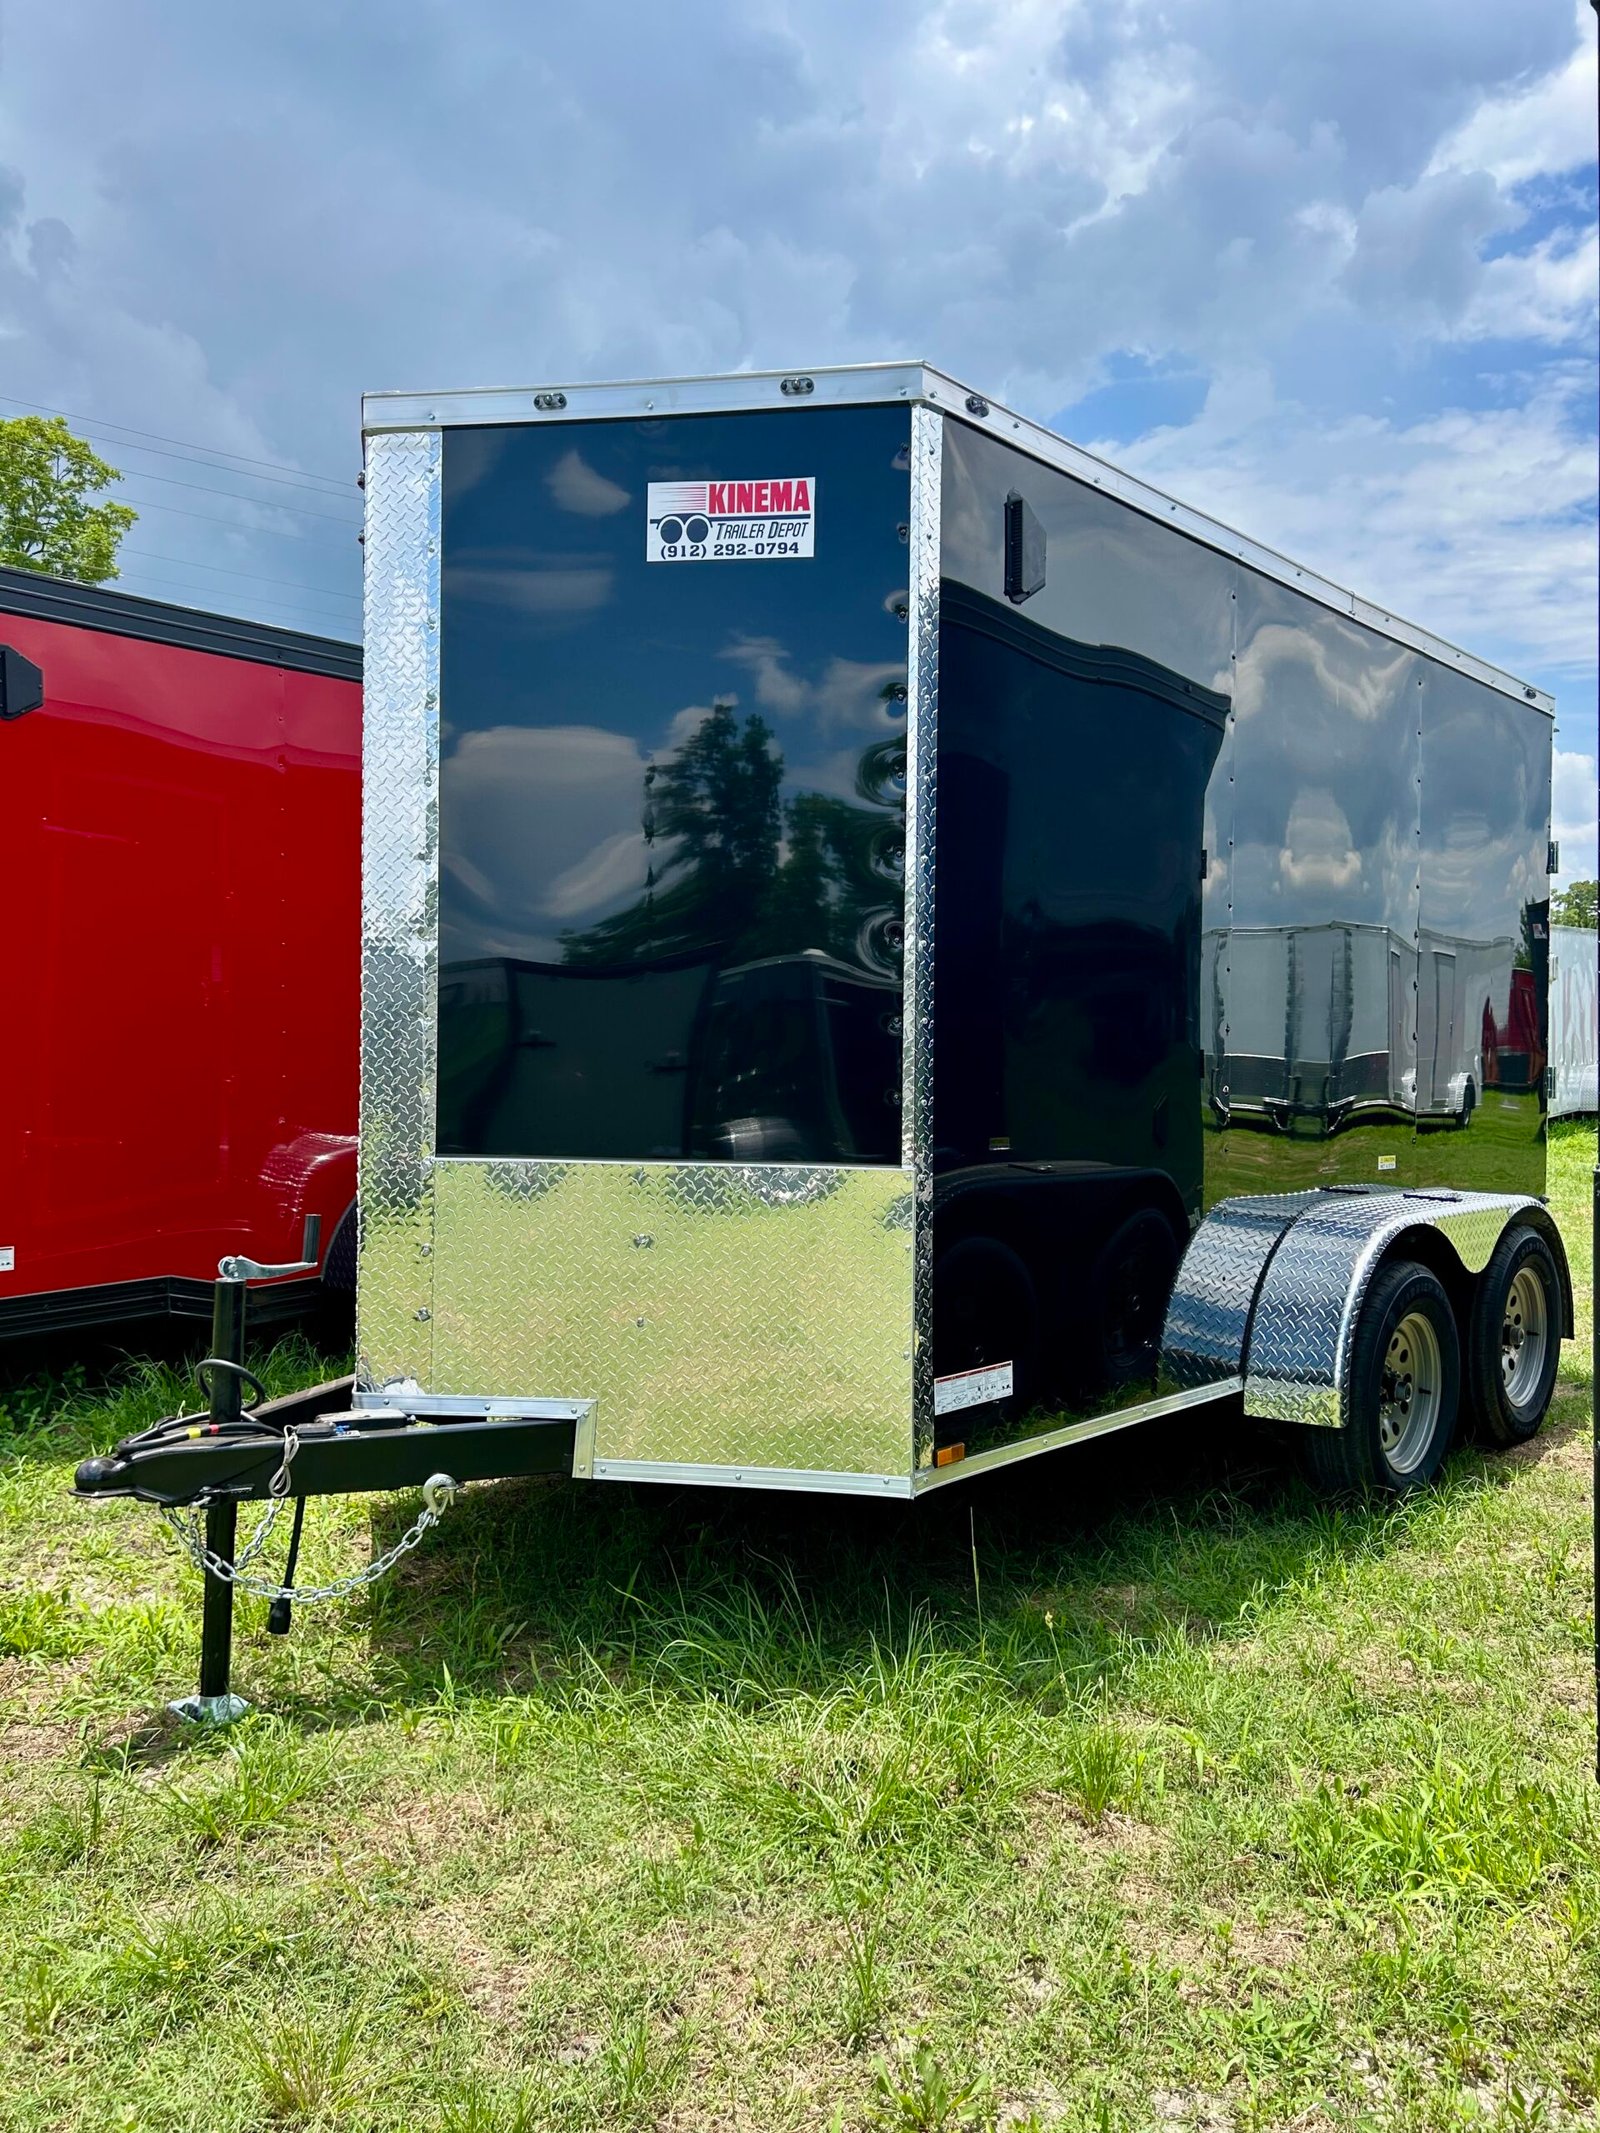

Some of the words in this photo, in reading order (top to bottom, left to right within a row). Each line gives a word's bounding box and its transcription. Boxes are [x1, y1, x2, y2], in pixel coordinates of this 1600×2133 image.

[708, 480, 811, 515] KINEMA
[716, 522, 766, 541] TRAILER
[767, 521, 809, 539] DEPOT
[660, 544, 707, 560] (912)
[713, 542, 799, 557] 292-0794
